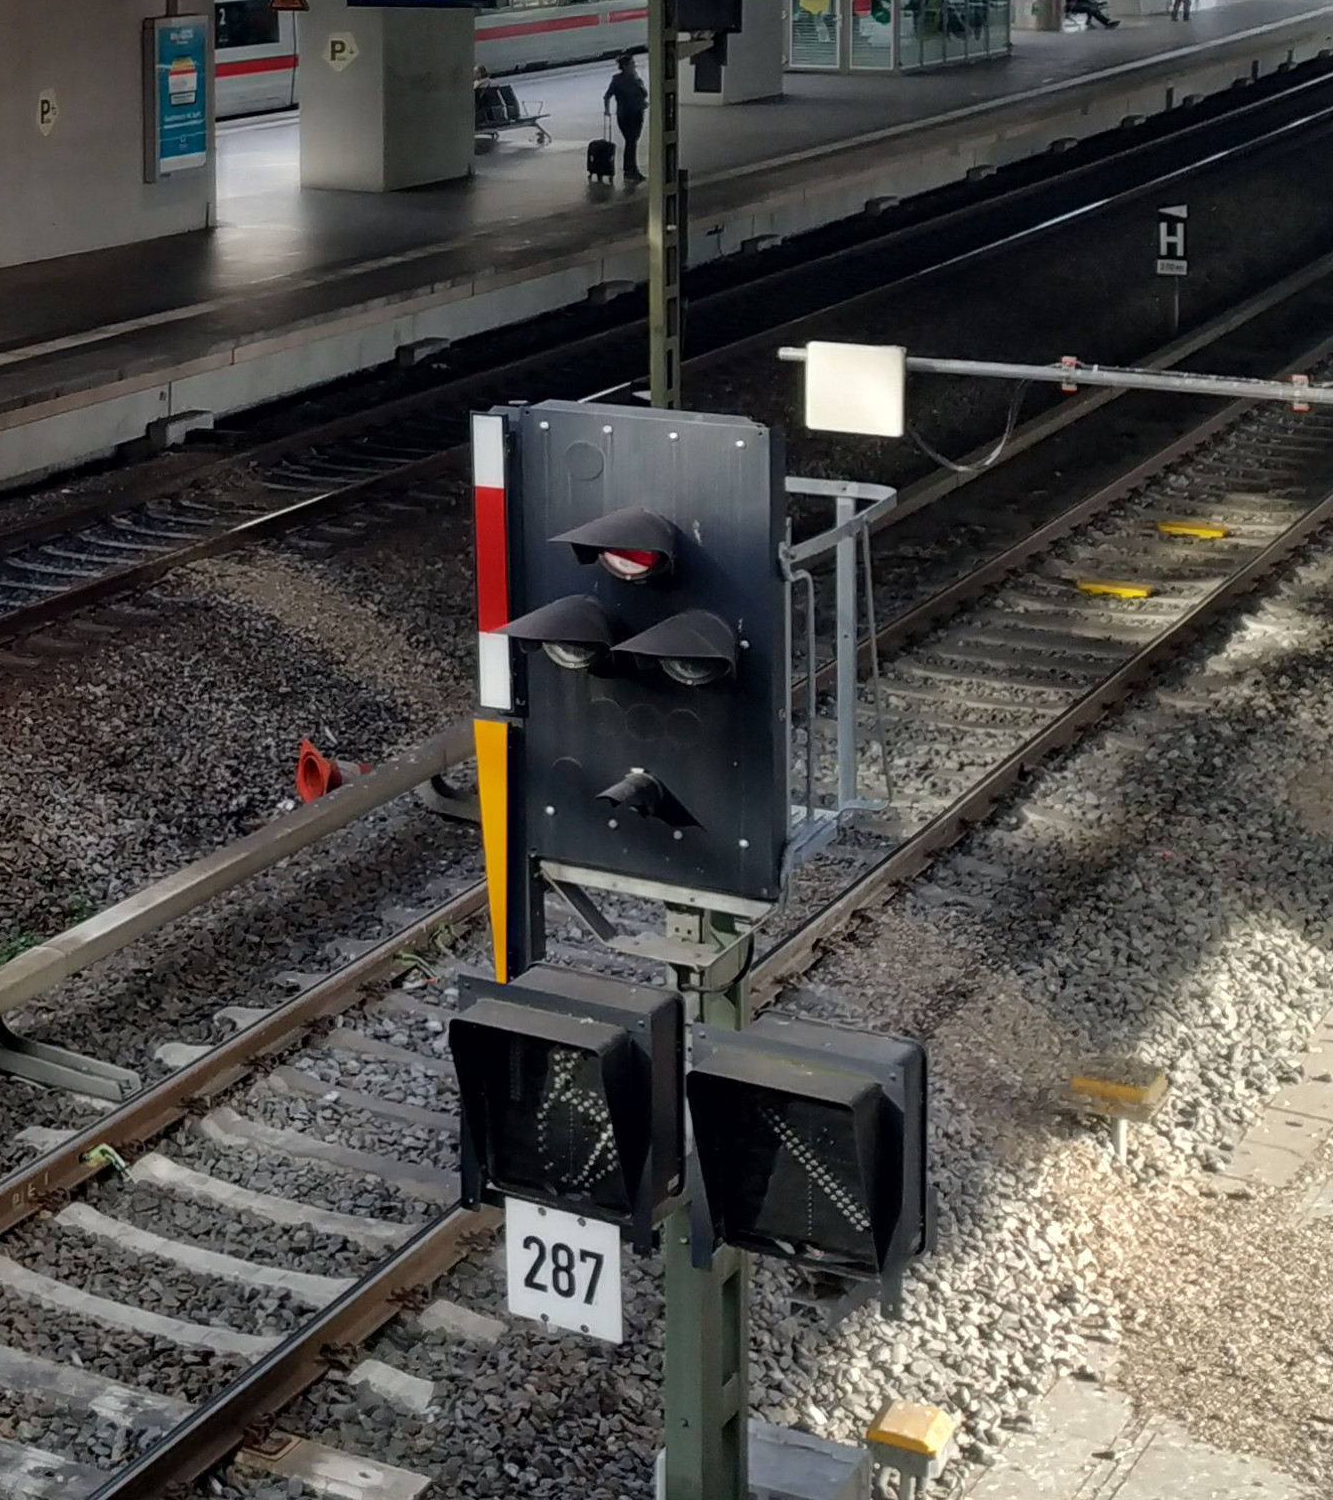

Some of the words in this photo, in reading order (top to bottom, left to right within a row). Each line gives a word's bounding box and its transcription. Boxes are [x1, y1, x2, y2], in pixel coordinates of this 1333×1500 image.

[219, 7, 226, 26] 2
[330, 39, 346, 61] P
[40, 99, 51, 125] P
[1159, 221, 1185, 257] H
[522, 1234, 605, 1306] 287
